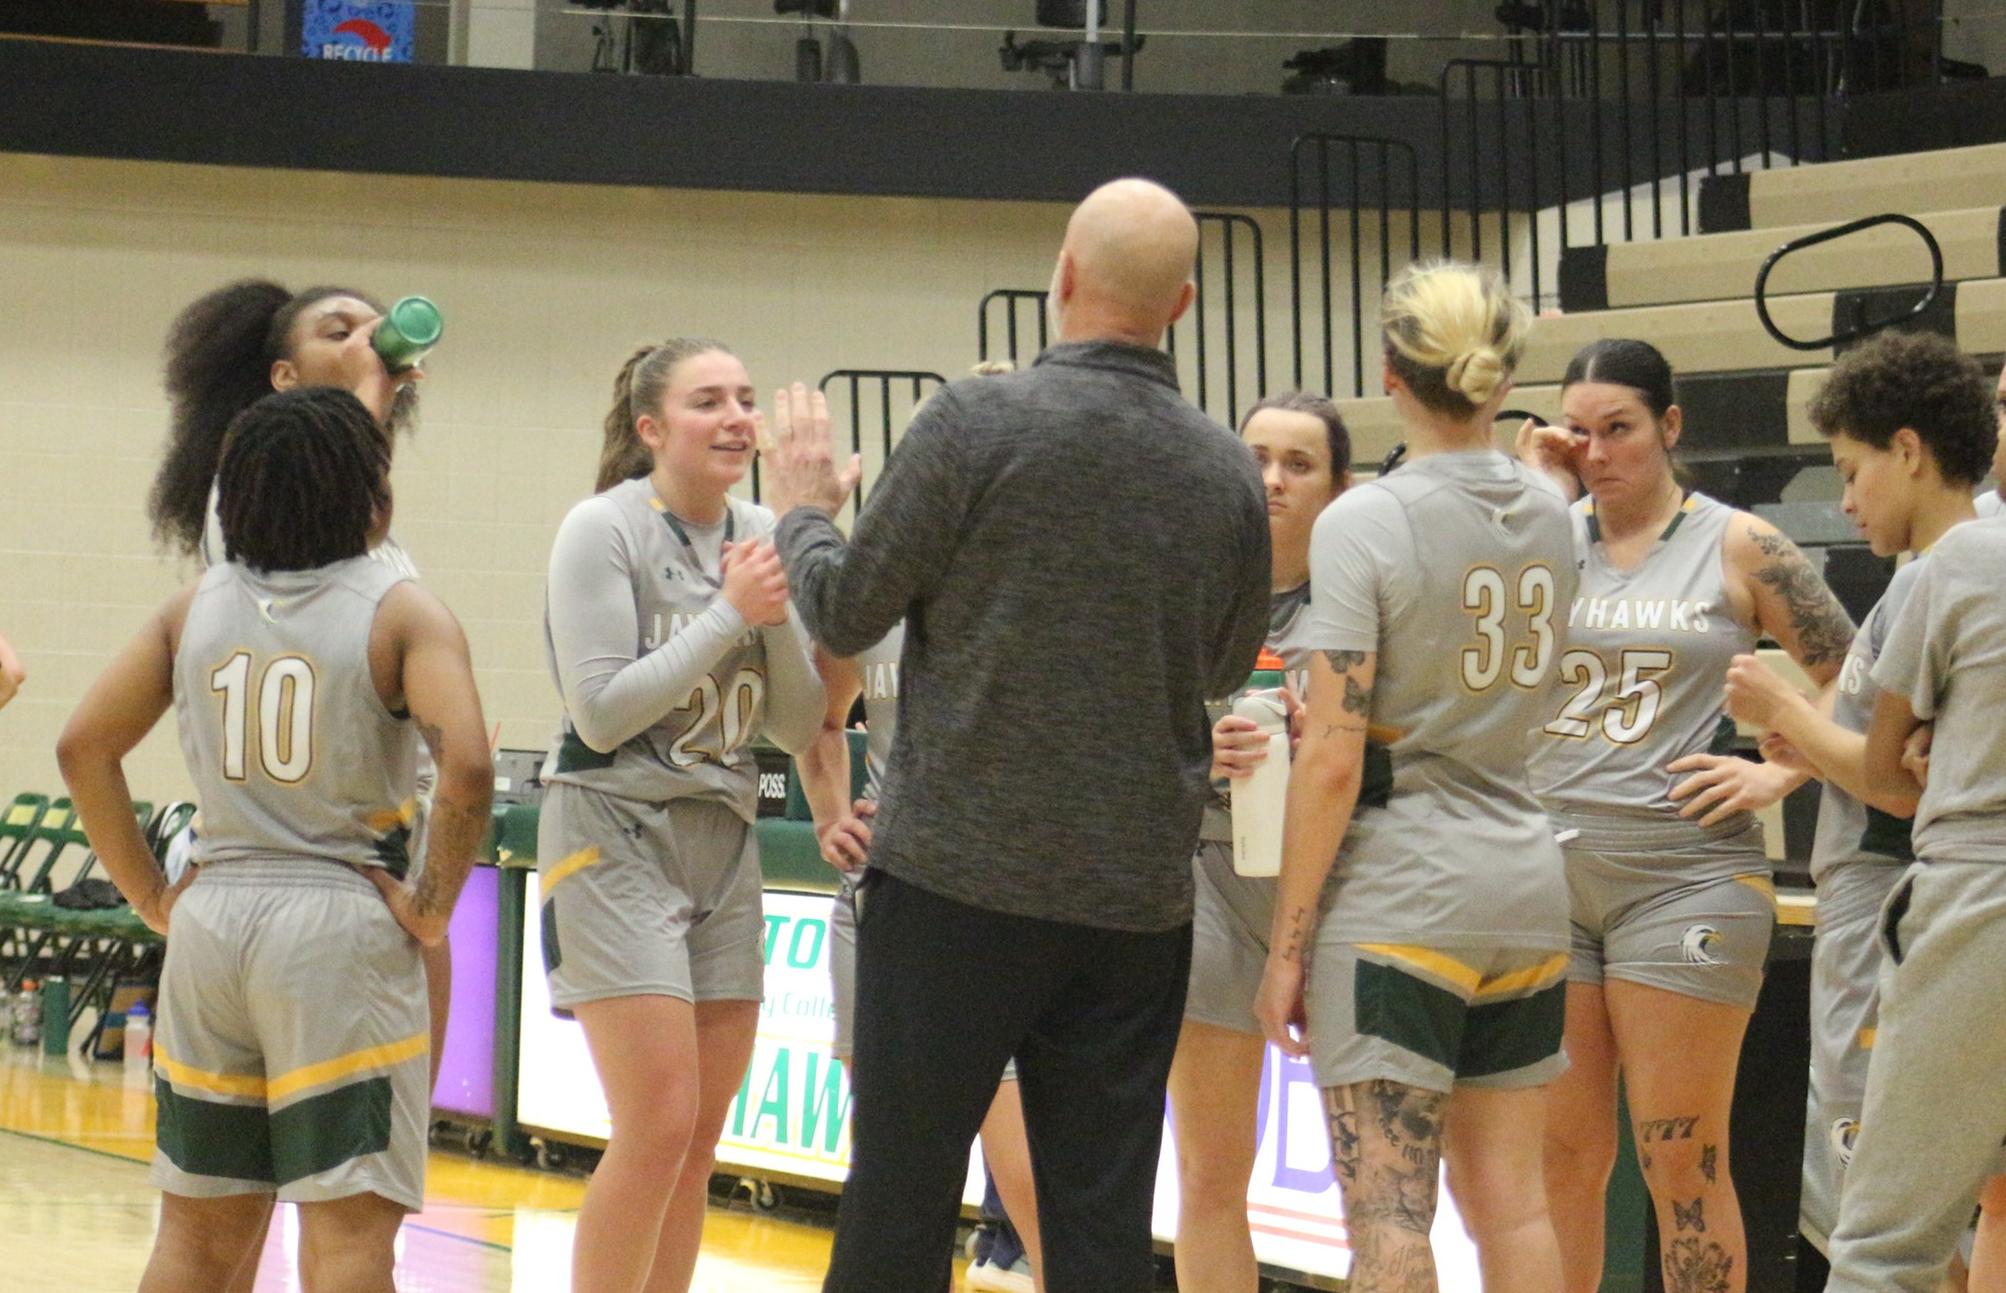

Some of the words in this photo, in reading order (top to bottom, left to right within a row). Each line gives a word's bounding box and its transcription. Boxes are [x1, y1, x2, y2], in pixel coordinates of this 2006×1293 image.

[1462, 564, 1554, 691] 33
[211, 652, 315, 783] 10
[670, 667, 763, 769] 20
[1544, 650, 1672, 744] 25
